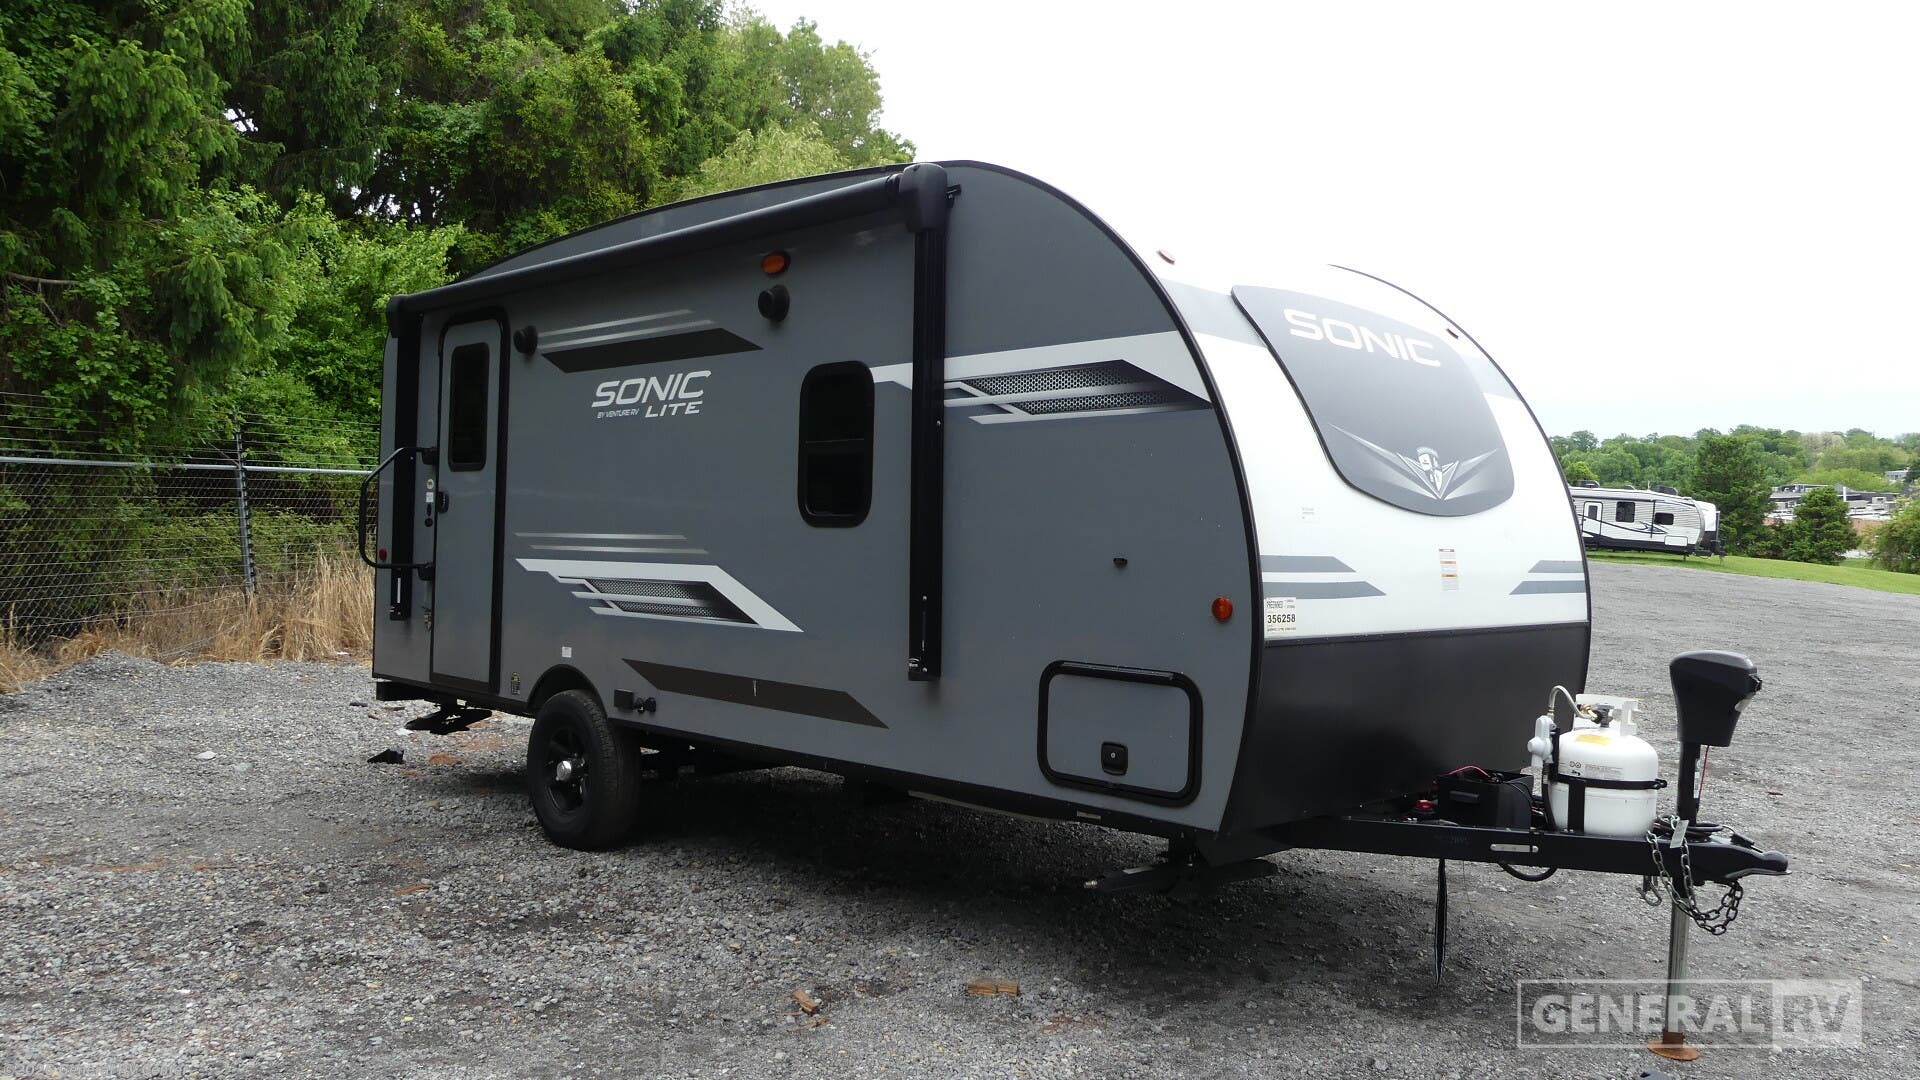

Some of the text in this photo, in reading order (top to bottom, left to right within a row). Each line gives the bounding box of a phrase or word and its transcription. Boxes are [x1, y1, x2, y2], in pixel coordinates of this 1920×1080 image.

[1283, 308, 1441, 367] SONIC
[591, 370, 712, 408] SONIC
[630, 408, 640, 416] RV
[645, 400, 703, 418] LITE
[1267, 613, 1296, 624] 356258
